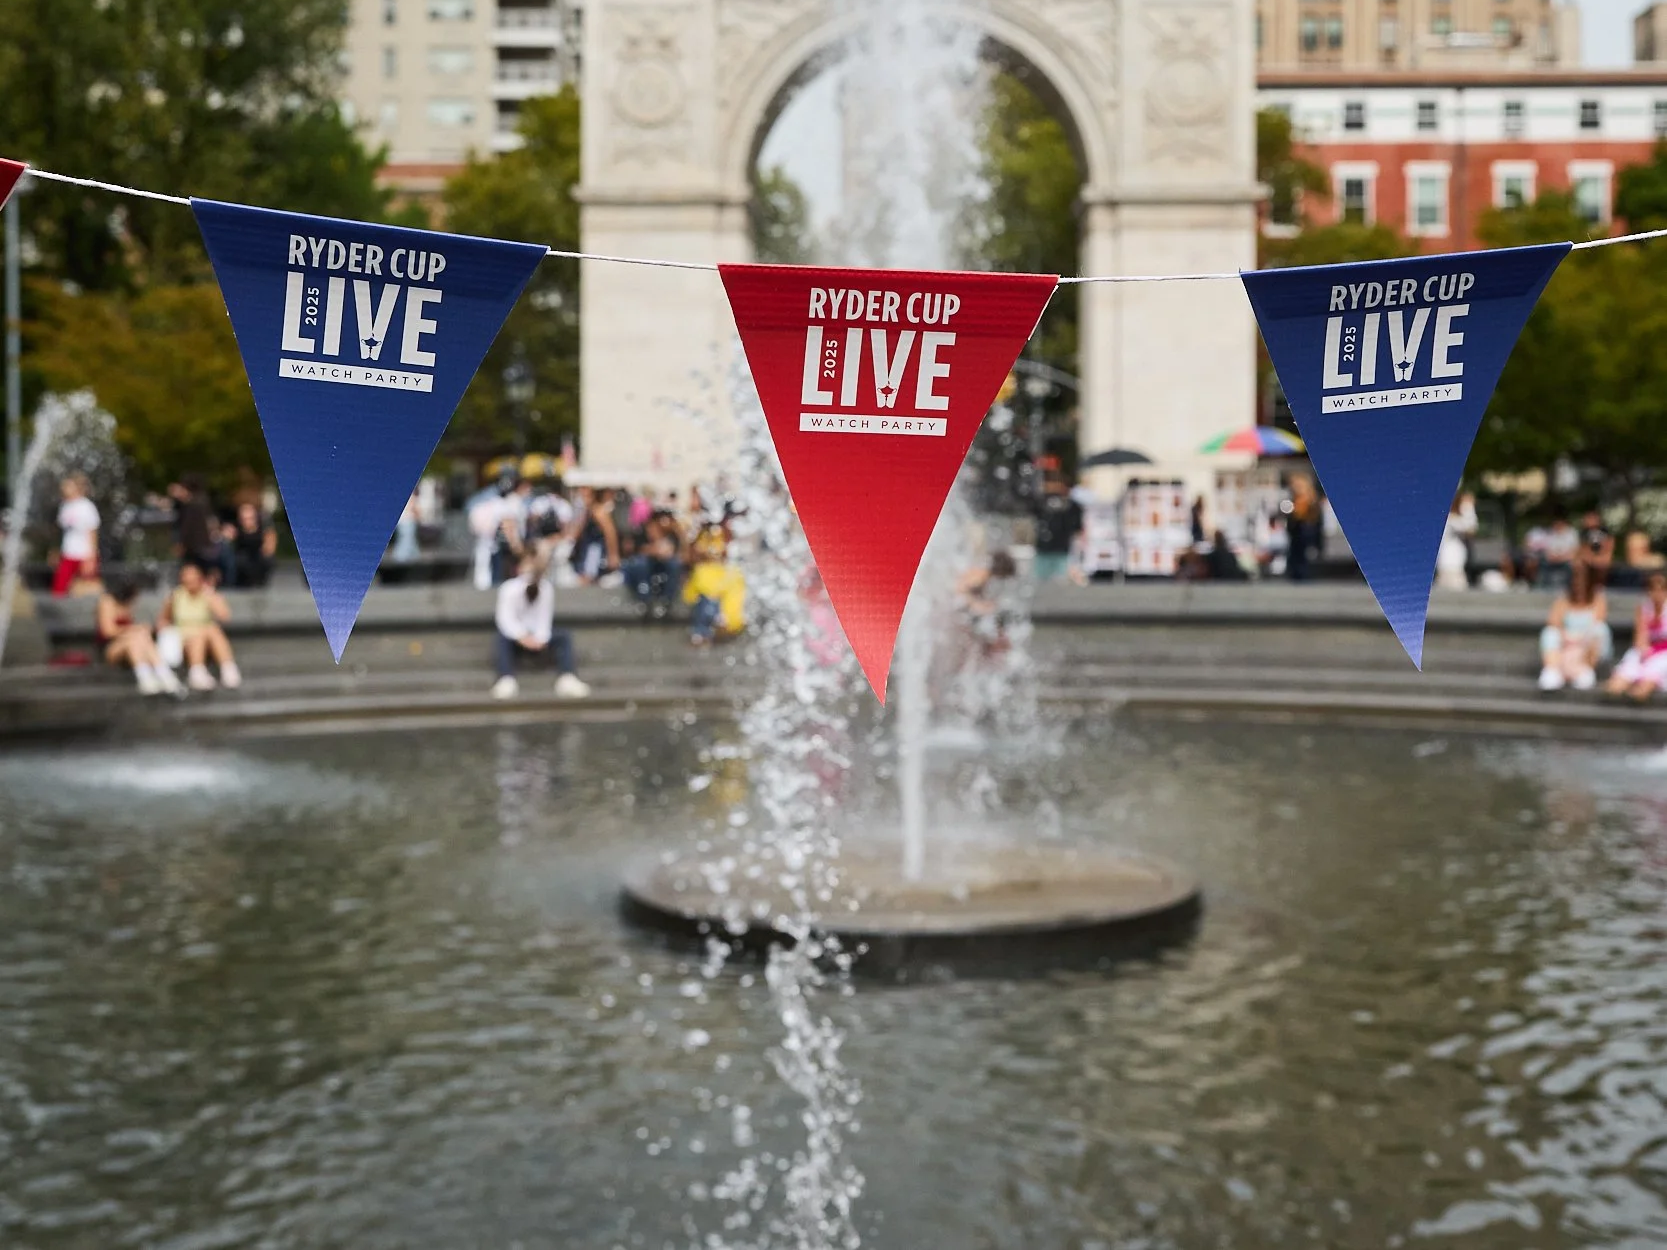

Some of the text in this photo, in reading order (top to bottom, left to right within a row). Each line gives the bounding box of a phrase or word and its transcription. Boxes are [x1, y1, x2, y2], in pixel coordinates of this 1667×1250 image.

[288, 234, 447, 282] RYDER CUP
[305, 287, 320, 326] 2025
[808, 287, 961, 325] RYDER CUP
[1329, 272, 1475, 312] RYDER CUP
[281, 271, 443, 367] LIVE
[824, 340, 838, 378] 2025
[1322, 303, 1470, 390] LIVE
[1343, 326, 1357, 362] 2025
[291, 364, 422, 386] WATCH PARTY
[801, 325, 957, 411] LIVE
[1333, 388, 1452, 408] WATCH PARTY
[811, 418, 936, 431] WATCH PARTY
